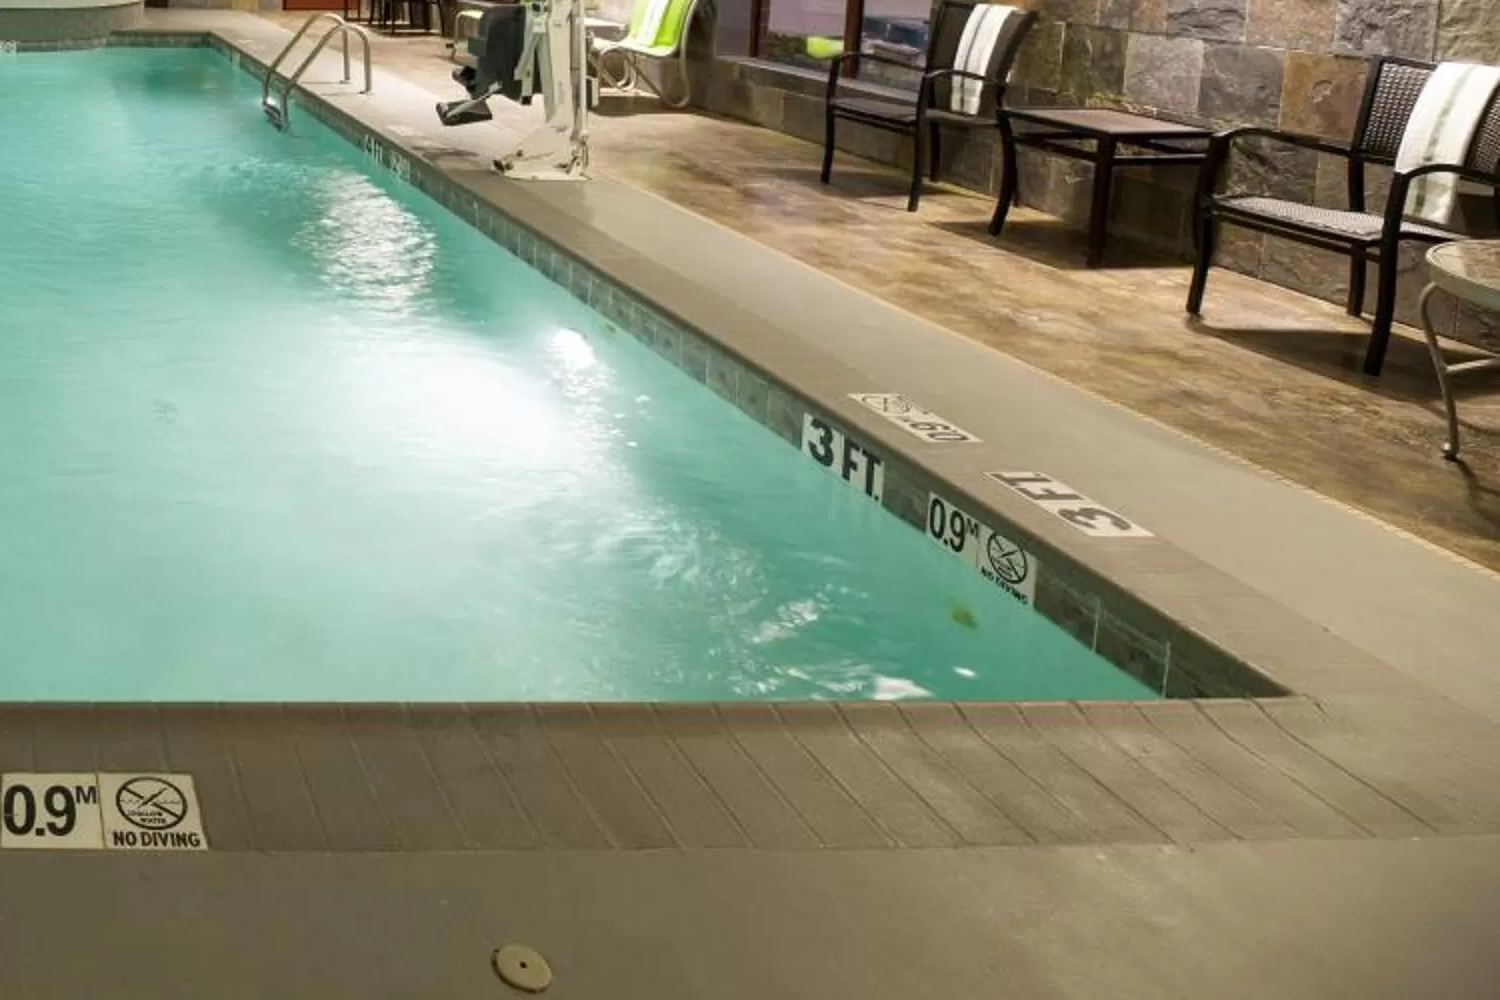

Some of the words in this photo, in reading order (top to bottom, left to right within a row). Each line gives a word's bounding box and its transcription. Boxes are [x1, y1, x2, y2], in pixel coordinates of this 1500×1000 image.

[808, 418, 834, 467] 3
[1058, 507, 1131, 531] 3
[113, 831, 137, 847] NO
[142, 832, 200, 848] DIVING
